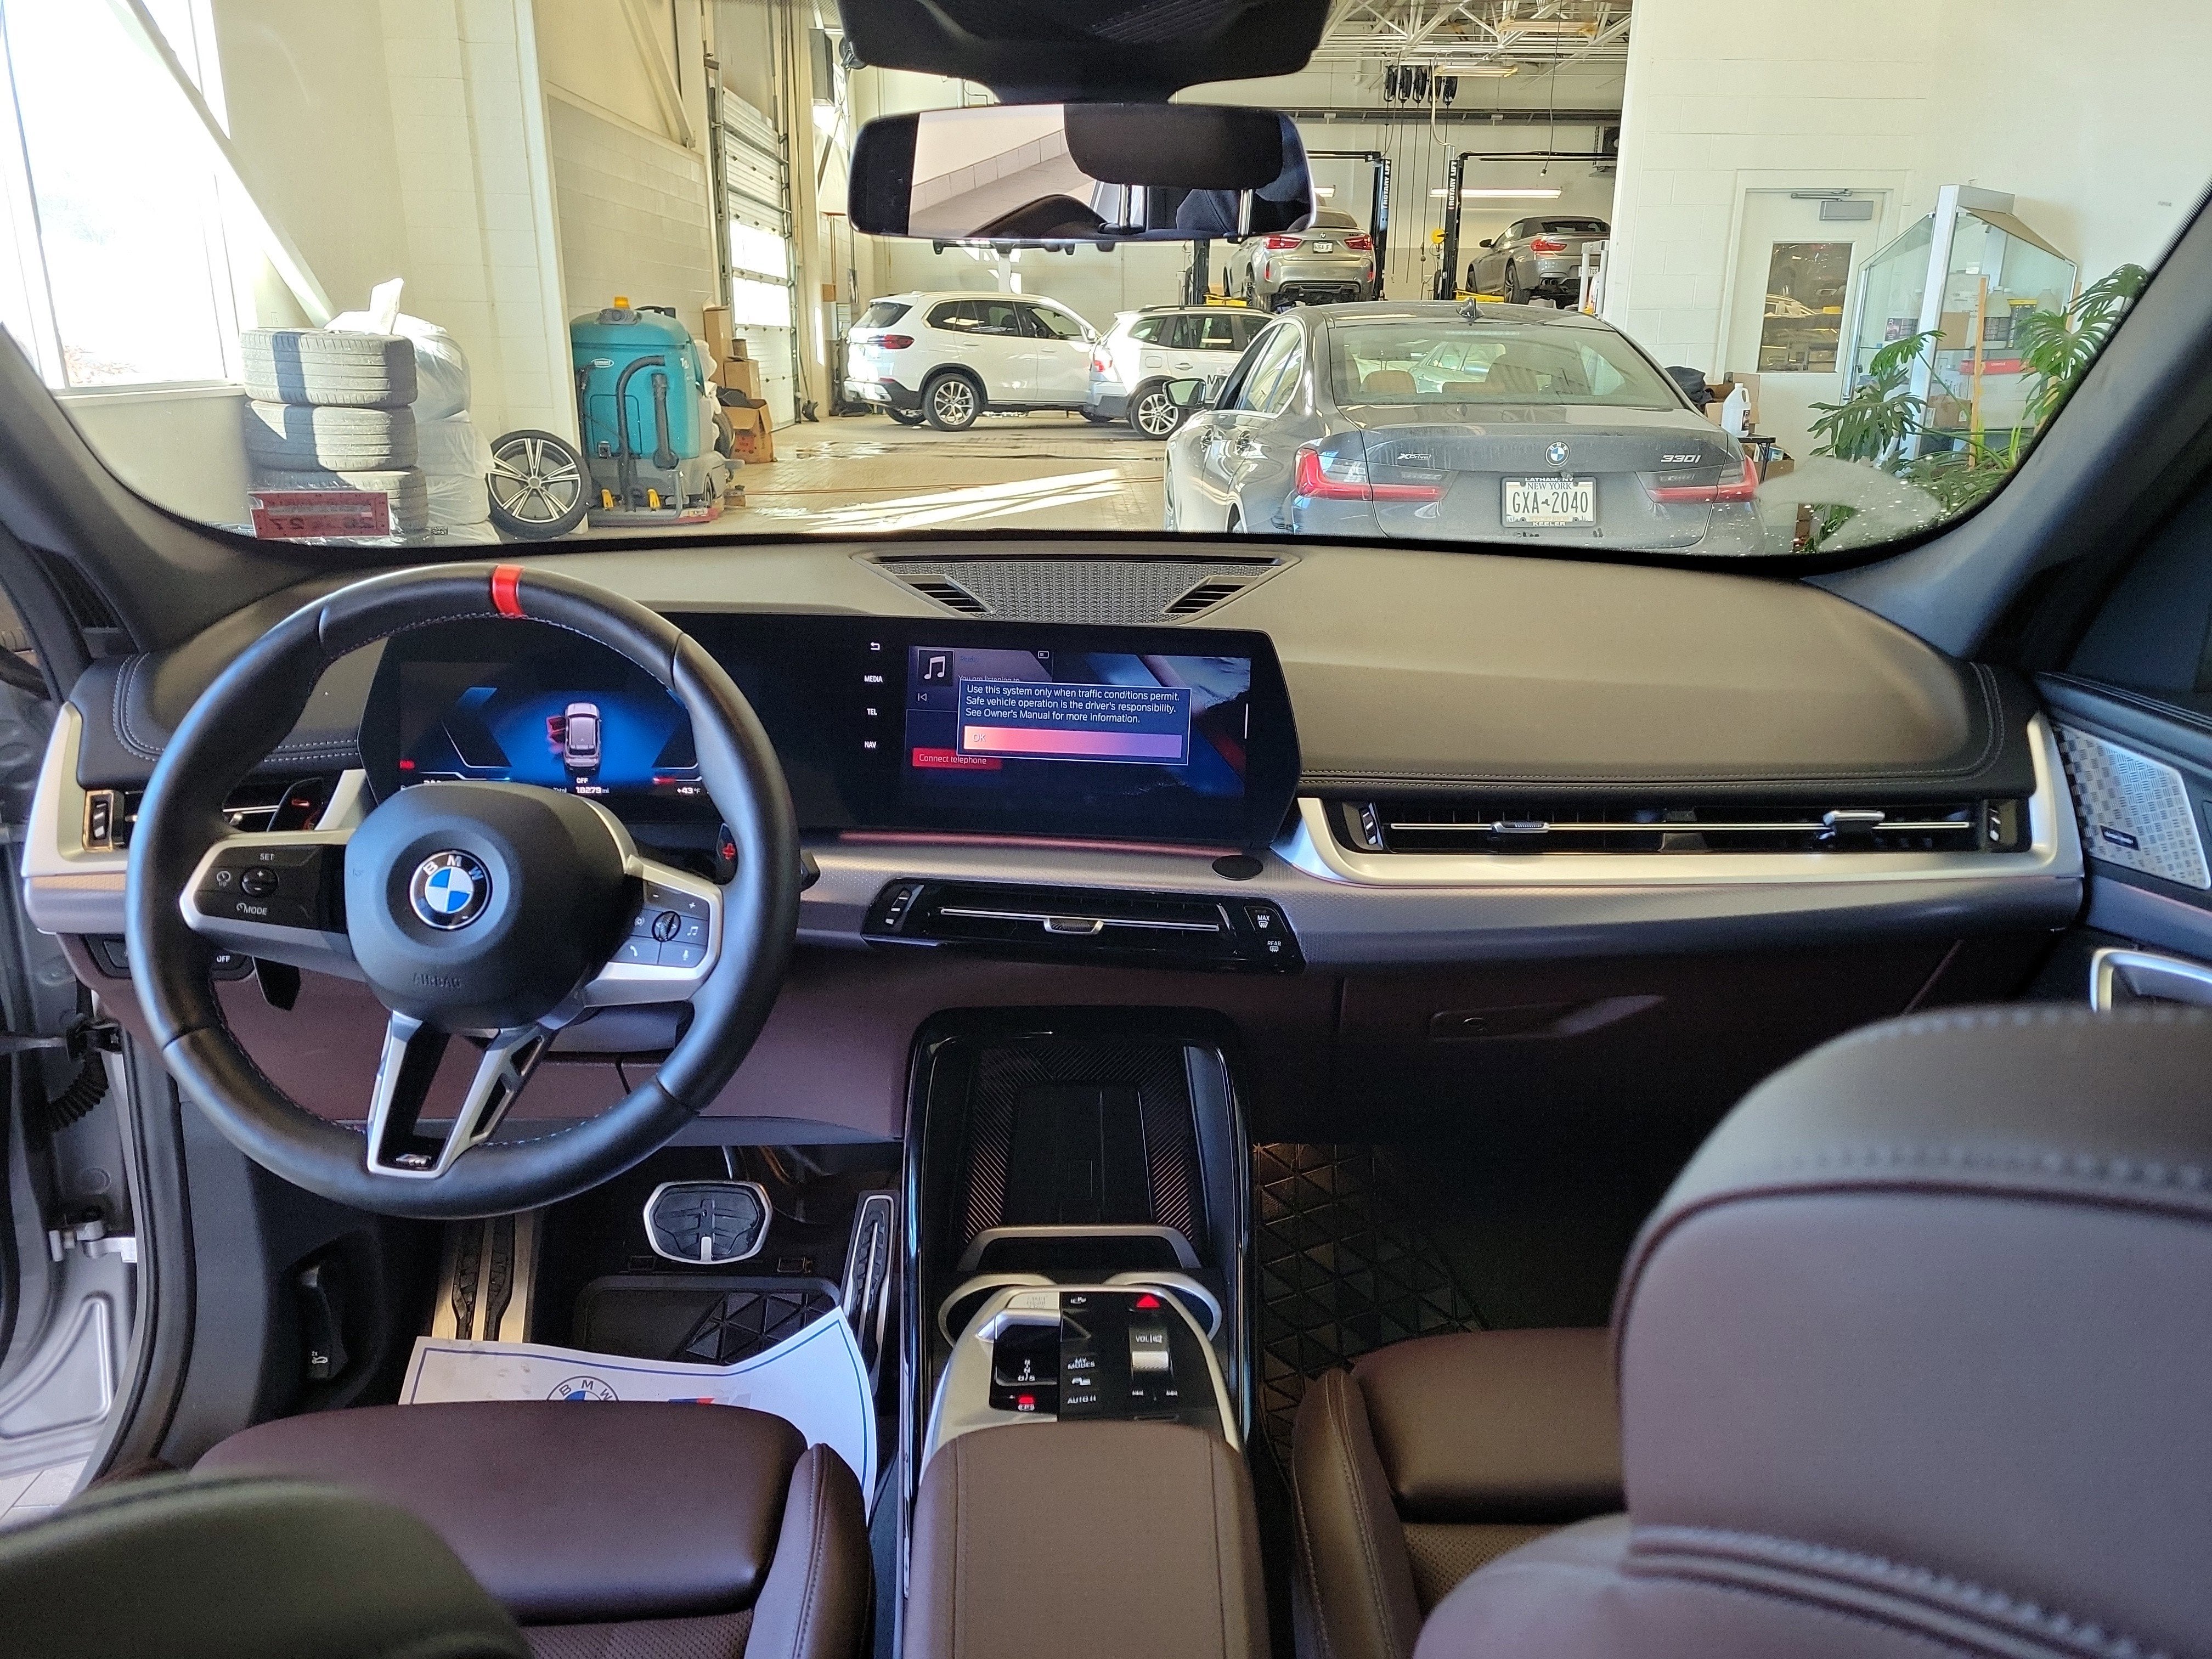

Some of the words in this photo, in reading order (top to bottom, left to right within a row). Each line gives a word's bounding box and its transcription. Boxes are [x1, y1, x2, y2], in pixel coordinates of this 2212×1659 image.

[1513, 492, 1539, 514] GXA
[1551, 492, 1588, 514] 2040
[967, 685, 983, 693] Use
[985, 685, 1001, 694] this
[1002, 687, 1032, 697] system
[1034, 687, 1052, 697] only
[1054, 688, 1076, 697] when
[1078, 689, 1102, 698] traffic
[1104, 690, 1148, 700] conditions
[1150, 692, 1180, 702] permit.
[966, 696, 985, 706] Safe
[987, 697, 1016, 707] vehicle
[1018, 699, 1058, 709] operation
[1060, 700, 1068, 709] is
[1069, 700, 1083, 709] the
[1085, 701, 1116, 710] driver's
[1118, 703, 1176, 714] responsibility.
[965, 708, 981, 716] See
[984, 708, 1018, 719] Owner's
[1019, 710, 1049, 720] Manual
[1052, 711, 1064, 720] for
[1090, 713, 1140, 724] information.
[973, 733, 986, 742] OK
[919, 753, 949, 763] Connect
[950, 756, 986, 765] telephone
[244, 906, 267, 916] MODE
[216, 955, 230, 963] OFF
[558, 1379, 613, 1401] BMW
[1067, 1395, 1088, 1404] AUTO
